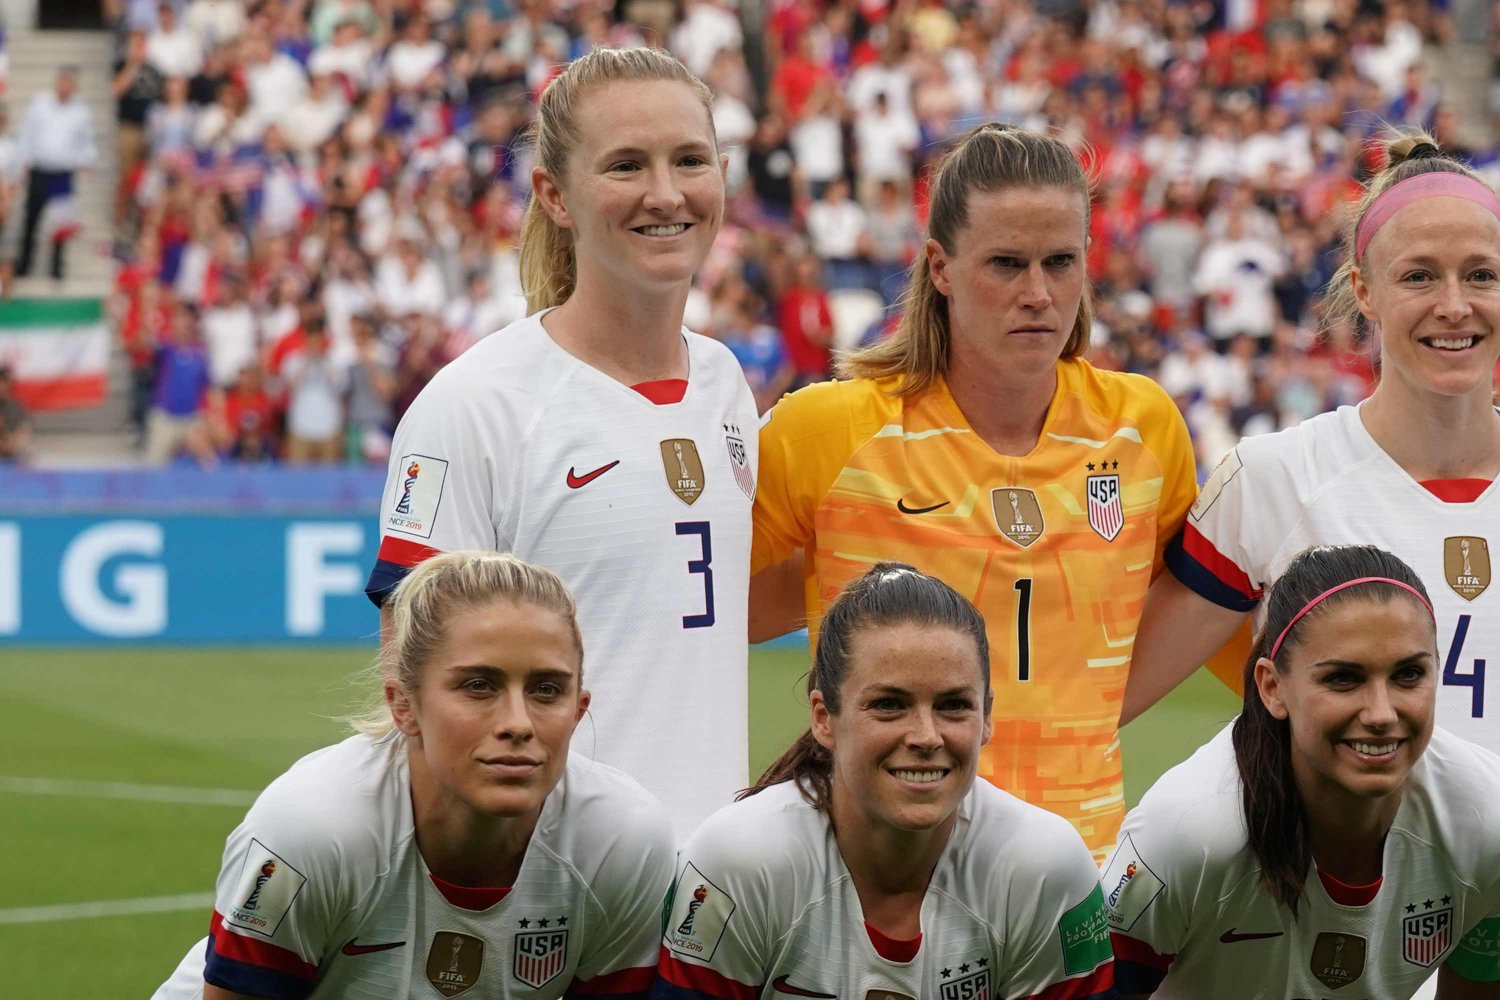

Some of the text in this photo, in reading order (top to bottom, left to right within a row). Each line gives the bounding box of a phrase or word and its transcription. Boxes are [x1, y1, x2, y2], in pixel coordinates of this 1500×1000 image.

[728, 441, 746, 465] USA
[677, 479, 697, 489] FIFA
[1090, 479, 1117, 504] USA
[405, 520, 423, 530] 2019
[1010, 524, 1033, 532] FIFA
[675, 521, 716, 629] 3
[1457, 576, 1480, 585] FIFA
[1014, 578, 1033, 682] 1
[1442, 614, 1487, 719] 4
[250, 917, 268, 928] 2019
[1066, 915, 1106, 944] FOOTBAL
[1408, 912, 1449, 938] USA
[519, 933, 564, 957] USA
[686, 941, 704, 953] 2019
[439, 971, 464, 983] FIFA
[1324, 967, 1348, 977] FIFA
[946, 974, 986, 1000] USA
